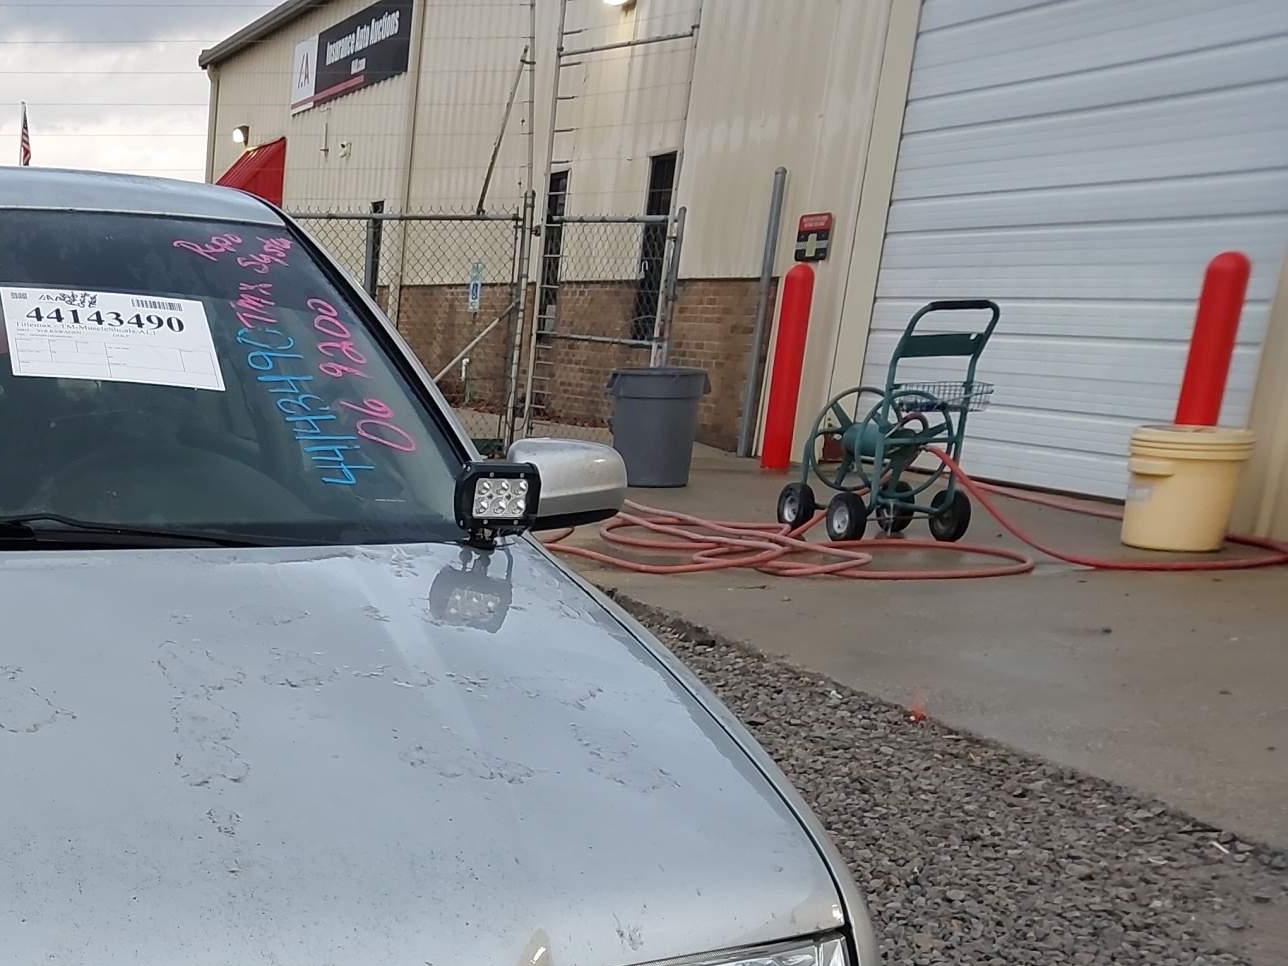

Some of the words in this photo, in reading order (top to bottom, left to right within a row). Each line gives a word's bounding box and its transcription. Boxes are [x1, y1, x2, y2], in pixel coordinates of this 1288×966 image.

[370, 10, 400, 46] Auctions
[26, 306, 184, 333] 44143490
[307, 298, 374, 379] 9200
[237, 328, 375, 485] 44143490
